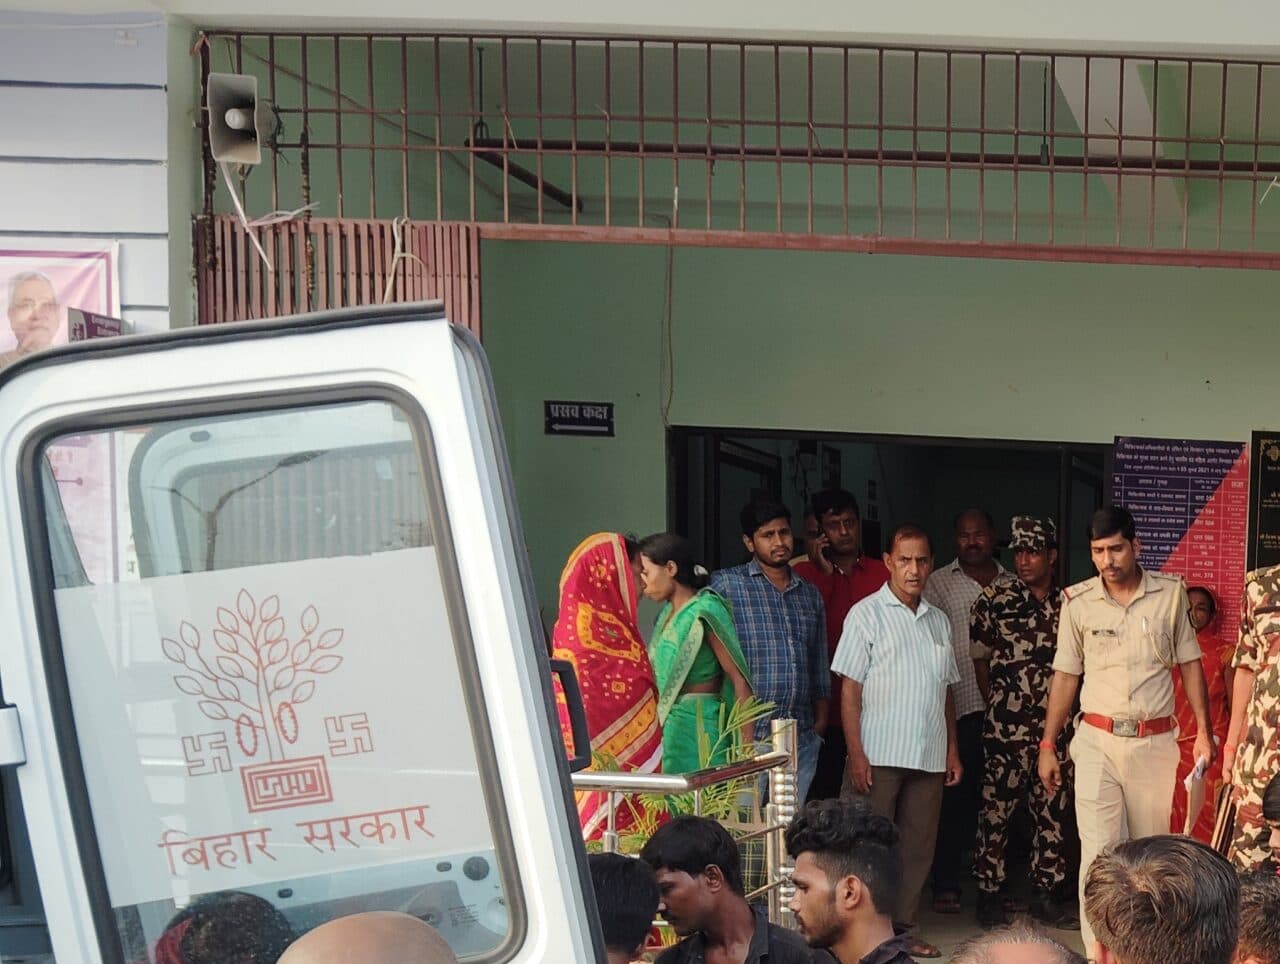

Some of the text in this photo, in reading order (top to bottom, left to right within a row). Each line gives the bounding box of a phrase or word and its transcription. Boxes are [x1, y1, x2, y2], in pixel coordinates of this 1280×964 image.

[582, 405, 608, 420] कक्ष
[158, 805, 435, 876] बिहार सरकार
